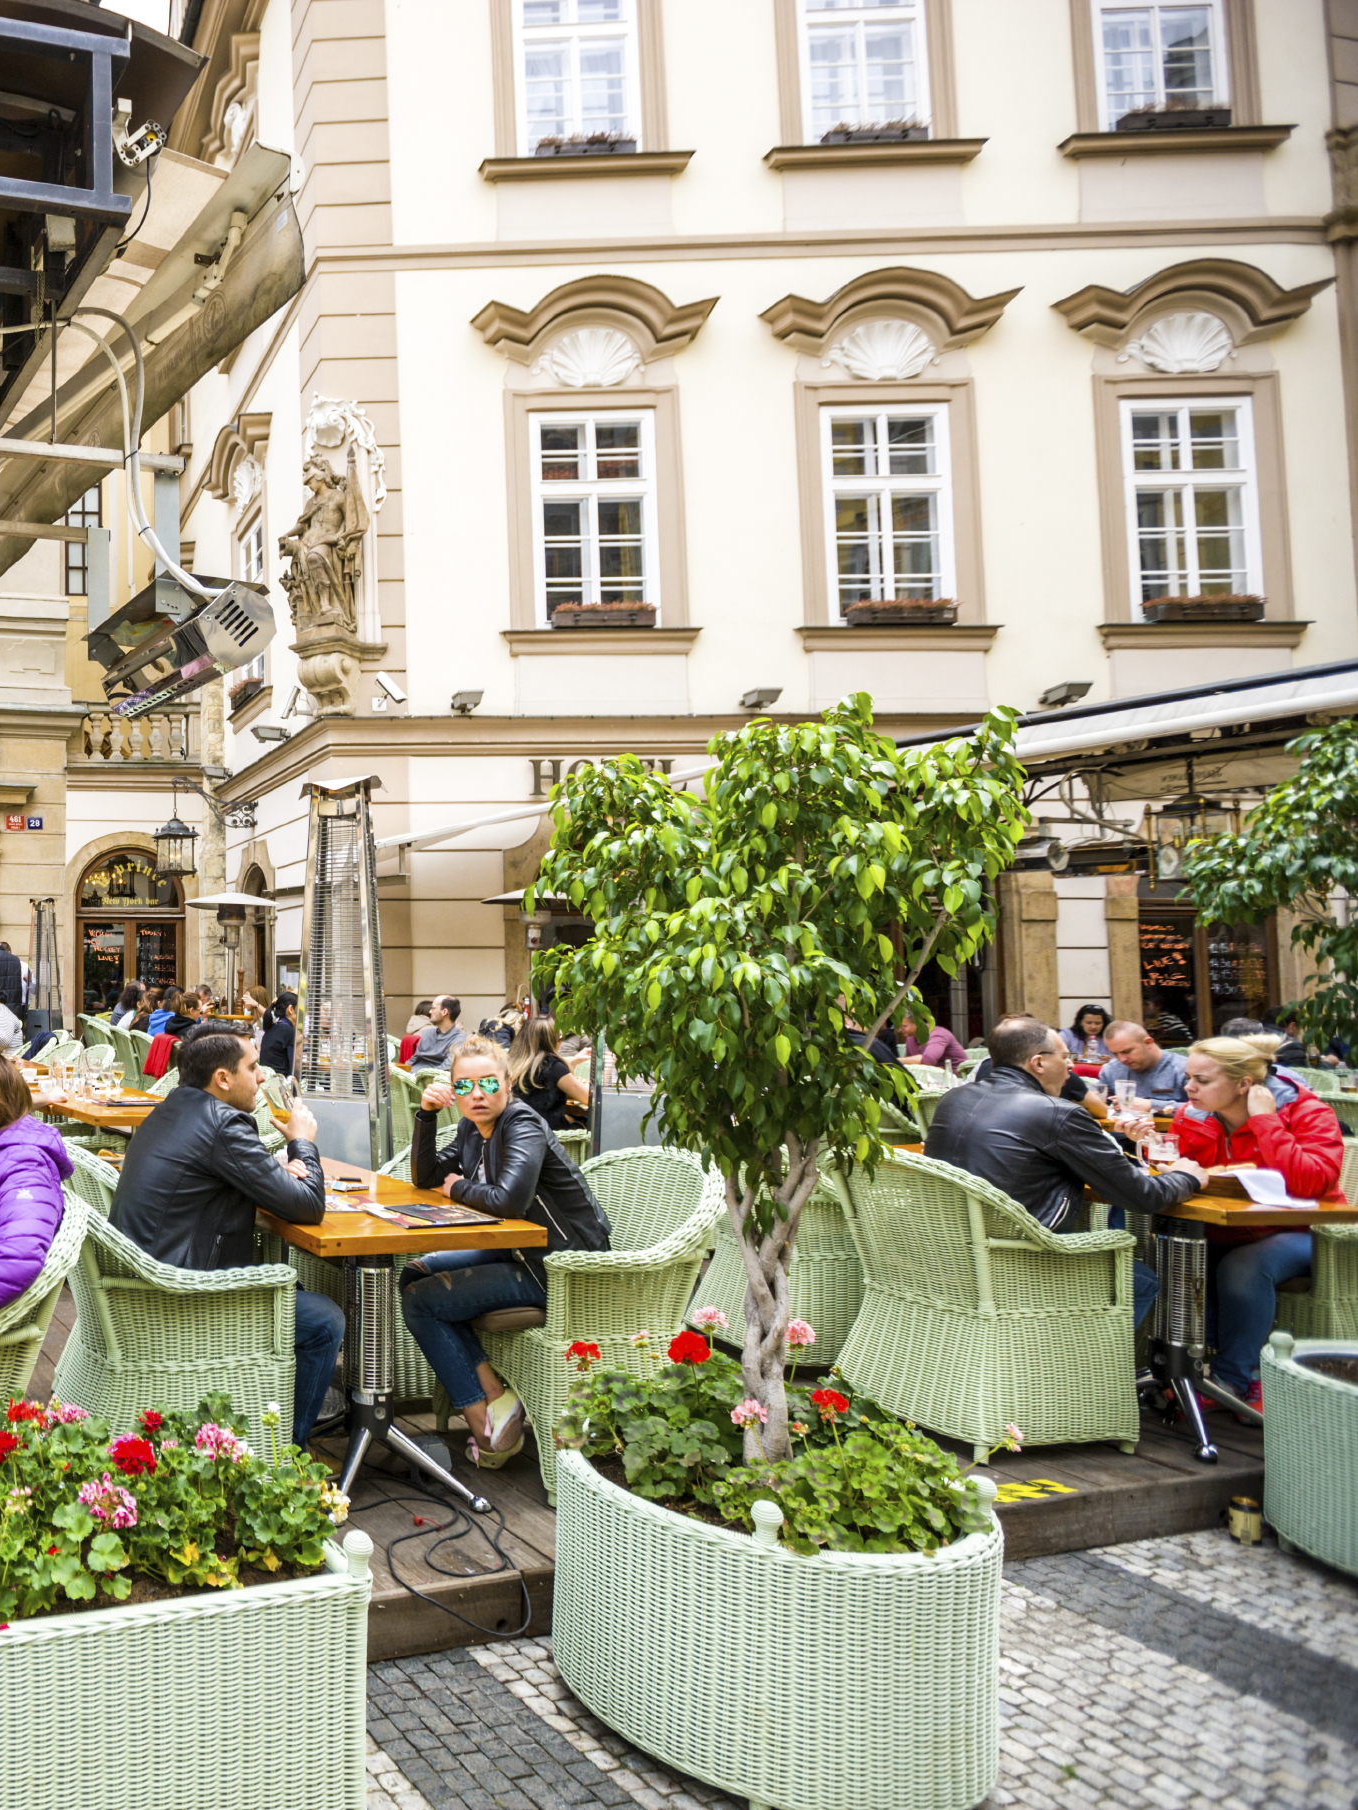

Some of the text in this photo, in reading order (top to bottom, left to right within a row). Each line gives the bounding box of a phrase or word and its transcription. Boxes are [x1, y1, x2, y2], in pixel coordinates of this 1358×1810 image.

[30, 819, 40, 827] 28
[101, 897, 159, 907] New York bar
